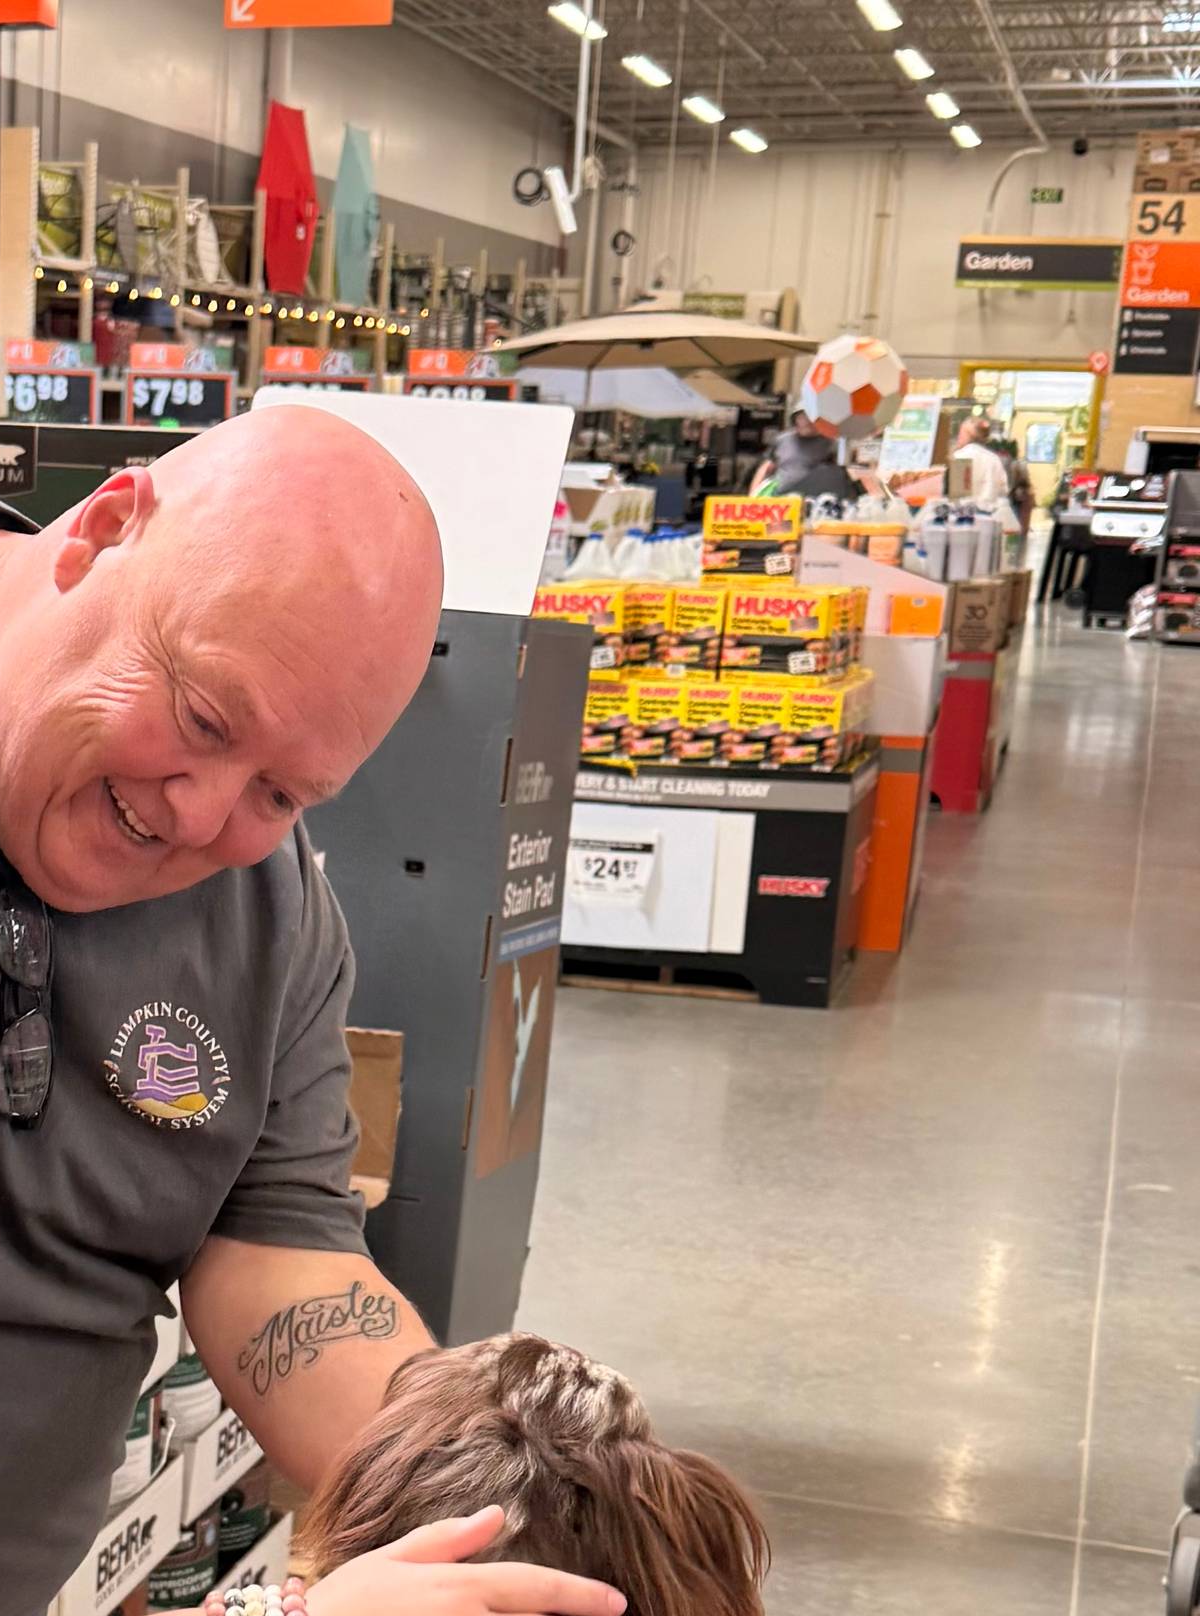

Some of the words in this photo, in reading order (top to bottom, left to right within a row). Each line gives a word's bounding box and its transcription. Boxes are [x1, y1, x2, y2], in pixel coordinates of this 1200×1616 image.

[1136, 200, 1187, 236] 54
[964, 251, 1034, 272] Garden
[1126, 286, 1190, 303] Garden
[713, 503, 790, 522] HUSKY
[533, 593, 613, 618] HUSKY
[734, 596, 817, 618] HUSKY
[659, 780, 725, 796] CLEANING
[728, 783, 771, 798] TODAY
[507, 830, 552, 870] Exterior
[502, 878, 533, 918] Stain
[533, 871, 556, 910] Pad
[758, 875, 830, 897] HUSKY
[110, 1001, 173, 1058] LUMPKIN
[175, 1007, 230, 1075] COUNTY
[170, 1087, 230, 1130] SYSTEM
[216, 1416, 247, 1467] BEH
[96, 1517, 140, 1594] BEHR
